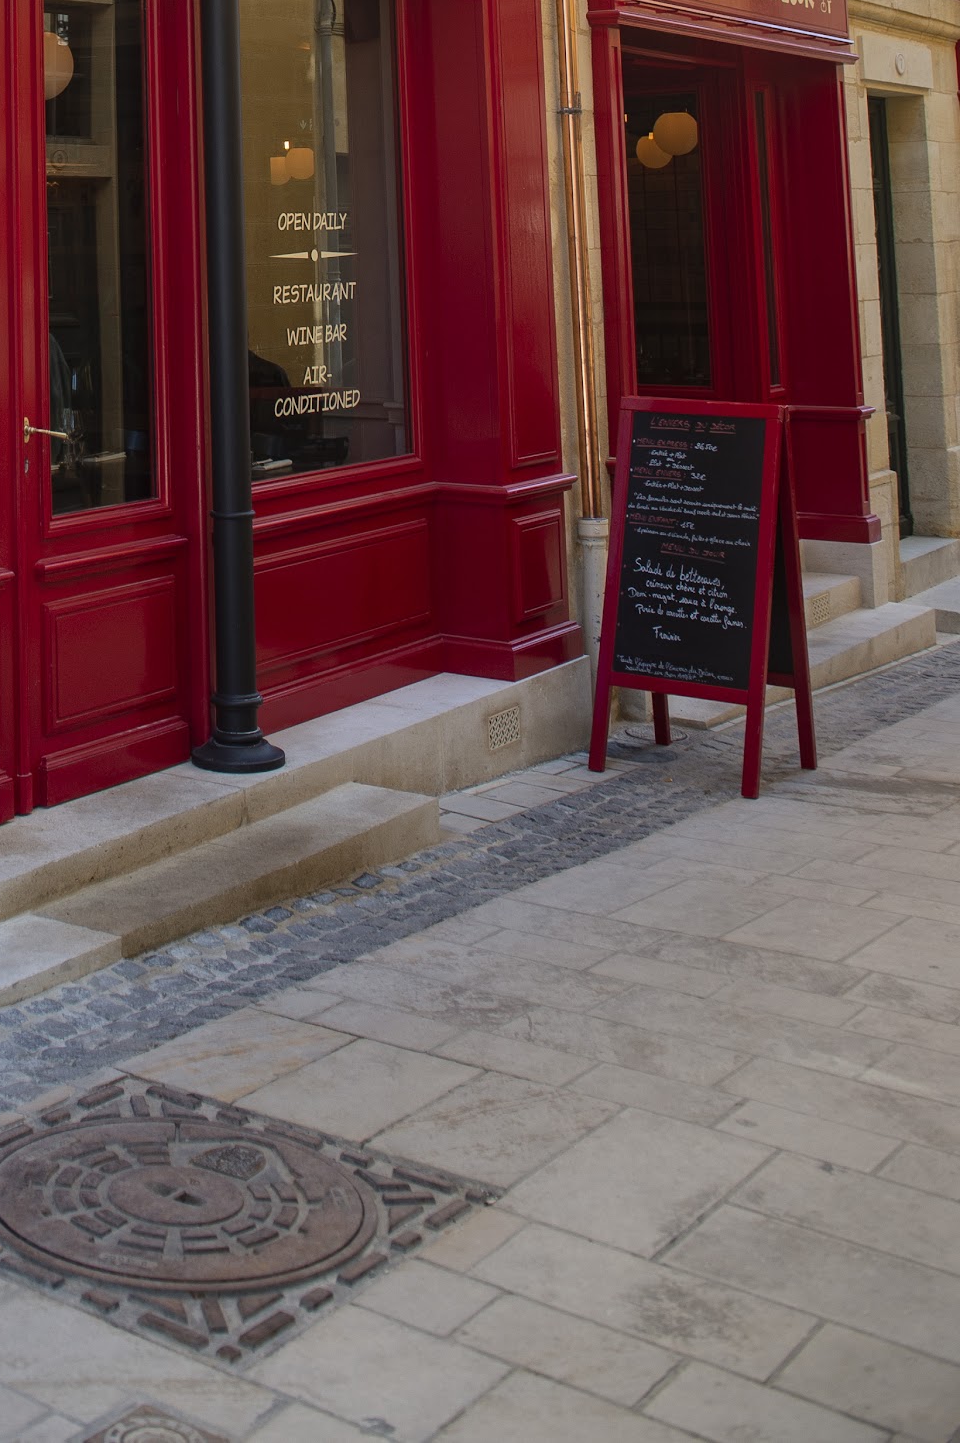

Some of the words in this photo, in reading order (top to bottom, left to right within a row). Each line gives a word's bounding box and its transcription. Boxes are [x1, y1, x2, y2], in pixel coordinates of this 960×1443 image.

[278, 213, 310, 231] OPEN
[313, 213, 347, 230] DAILY
[273, 282, 357, 304] RESTAURANT
[286, 326, 323, 346] WINE
[325, 324, 347, 342] BAR
[274, 389, 360, 417] CONDITIONED
[633, 557, 663, 576] Salade
[666, 563, 676, 578] de
